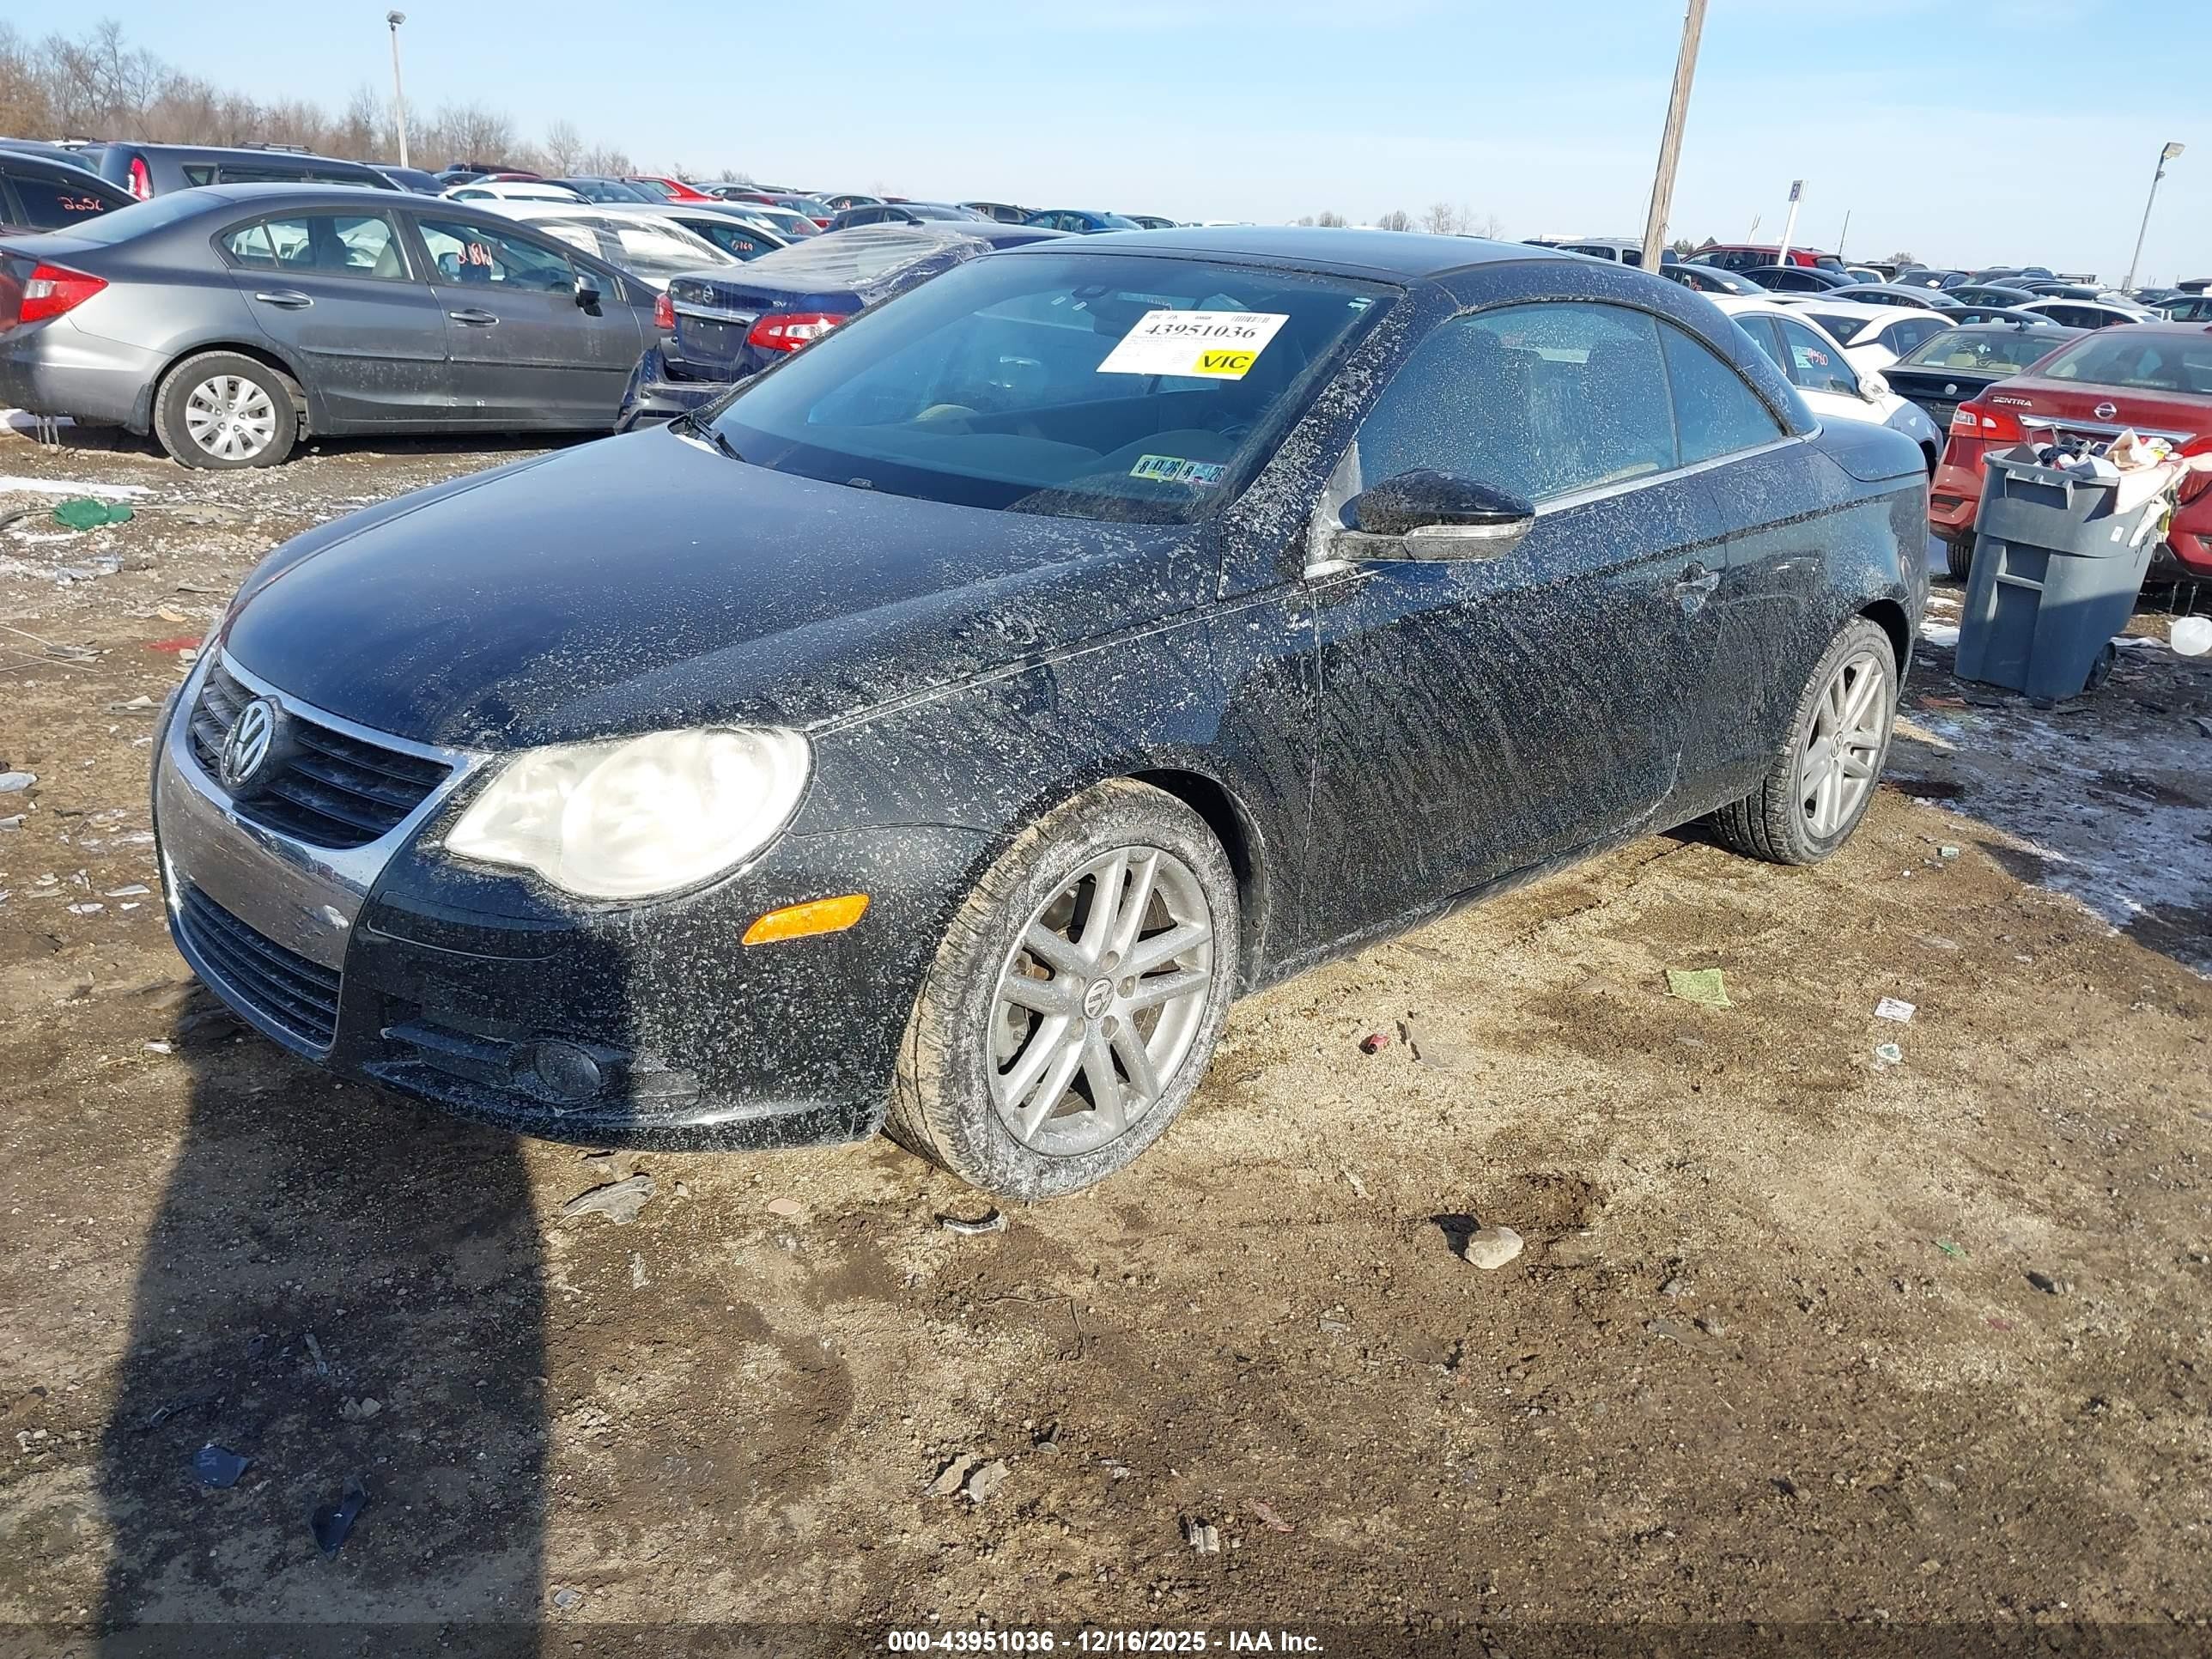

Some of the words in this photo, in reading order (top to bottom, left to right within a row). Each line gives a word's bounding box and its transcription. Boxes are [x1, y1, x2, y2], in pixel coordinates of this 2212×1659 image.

[1146, 324, 1259, 338] 43951036
[1203, 355, 1251, 369] VIC
[1991, 396, 2033, 407] SENTRA
